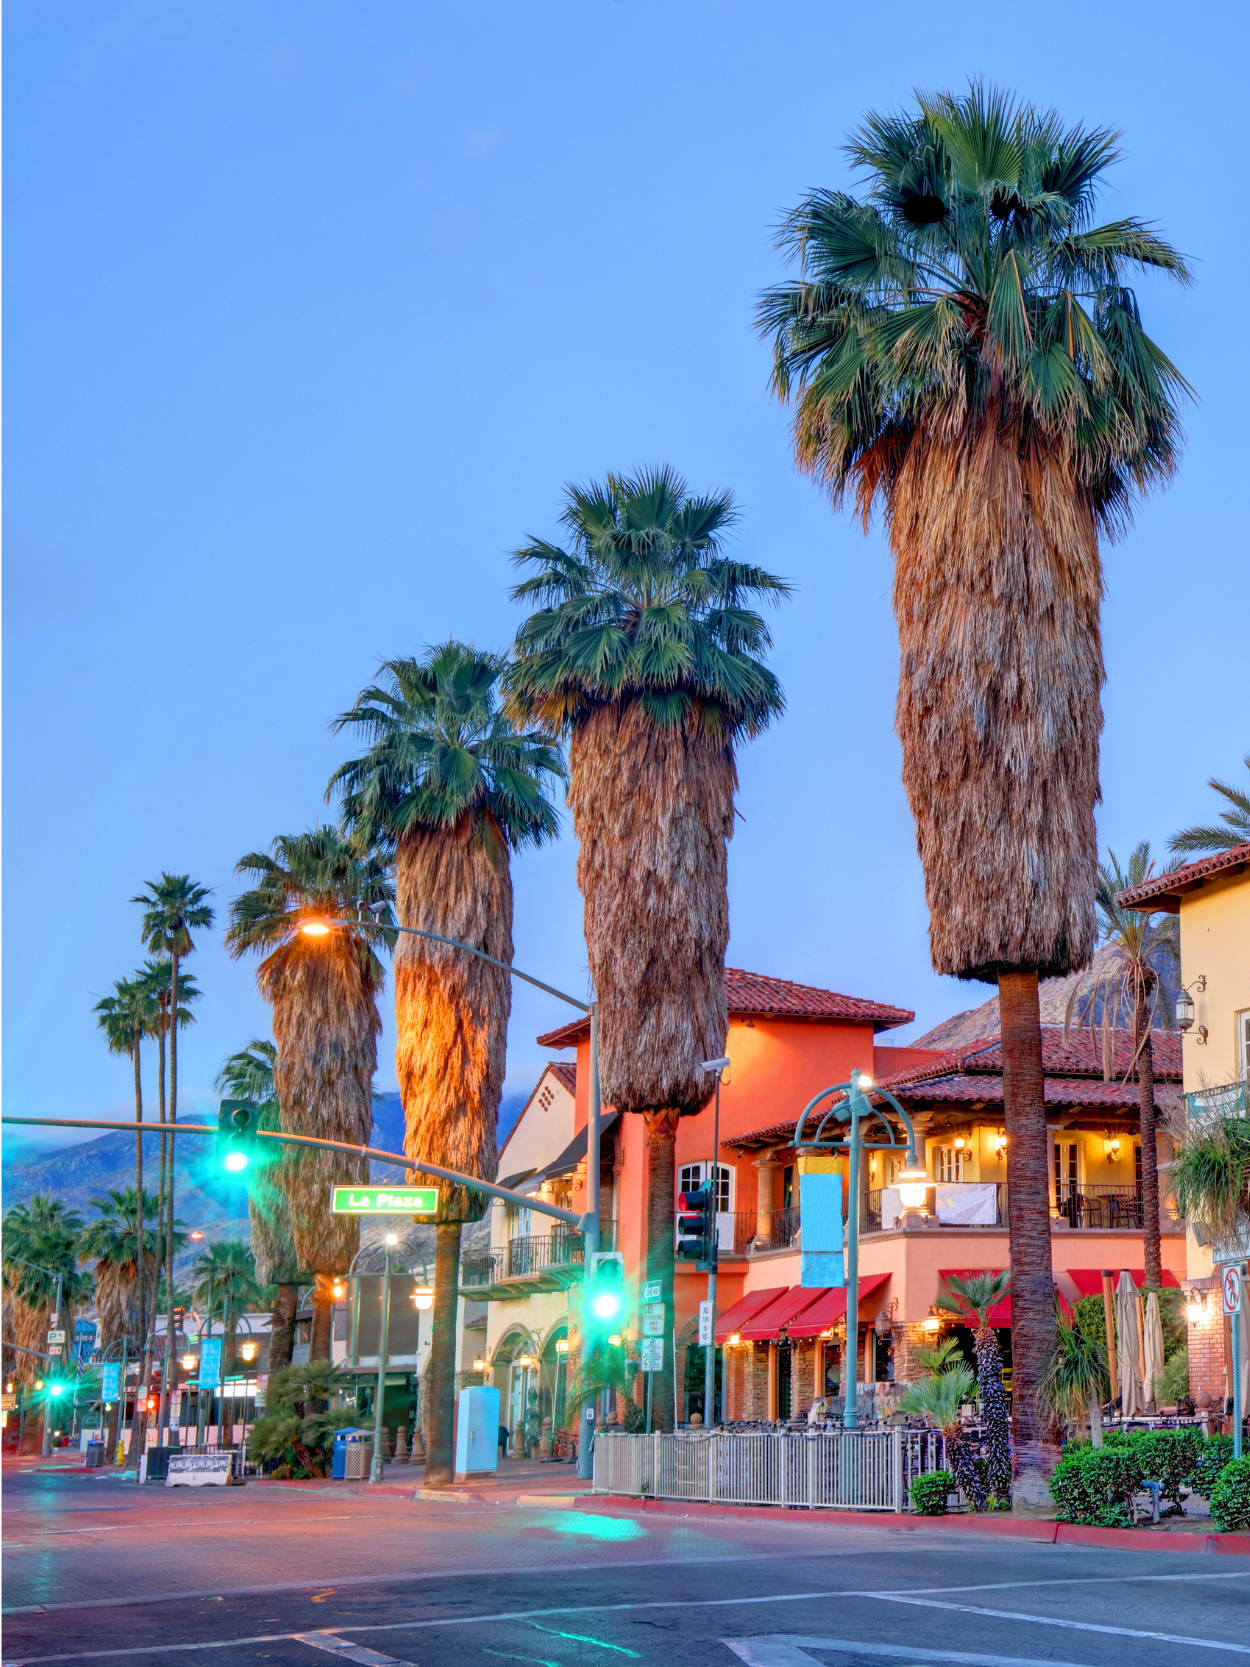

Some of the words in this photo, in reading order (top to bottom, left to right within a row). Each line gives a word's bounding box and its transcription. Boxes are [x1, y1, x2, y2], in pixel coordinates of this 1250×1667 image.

[348, 1193, 370, 1207] La
[376, 1193, 423, 1208] Plaza
[644, 1303, 653, 1313] NO
[703, 1306, 709, 1314] NO
[49, 1332, 57, 1341] P
